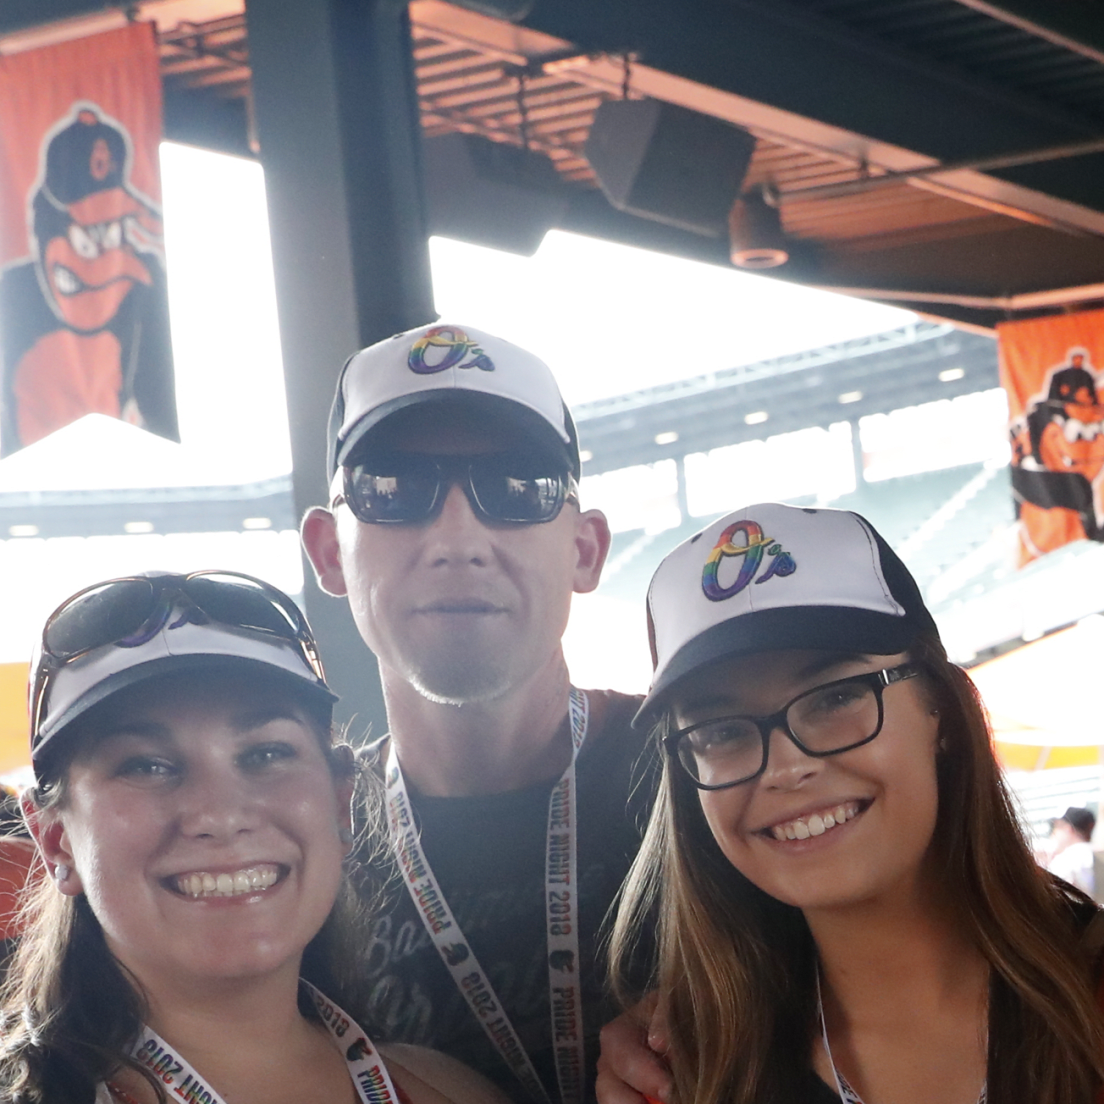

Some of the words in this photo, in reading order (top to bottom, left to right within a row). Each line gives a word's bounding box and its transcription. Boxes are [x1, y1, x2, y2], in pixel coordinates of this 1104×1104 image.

[408, 326, 495, 374] O's
[702, 520, 796, 602] O's
[549, 833, 570, 886] NIGHT
[414, 879, 452, 935] PRIDE
[550, 891, 572, 936] 2018
[460, 972, 497, 1018] 2018
[553, 986, 578, 1042] PRIDE
[136, 1039, 184, 1084] 2018
